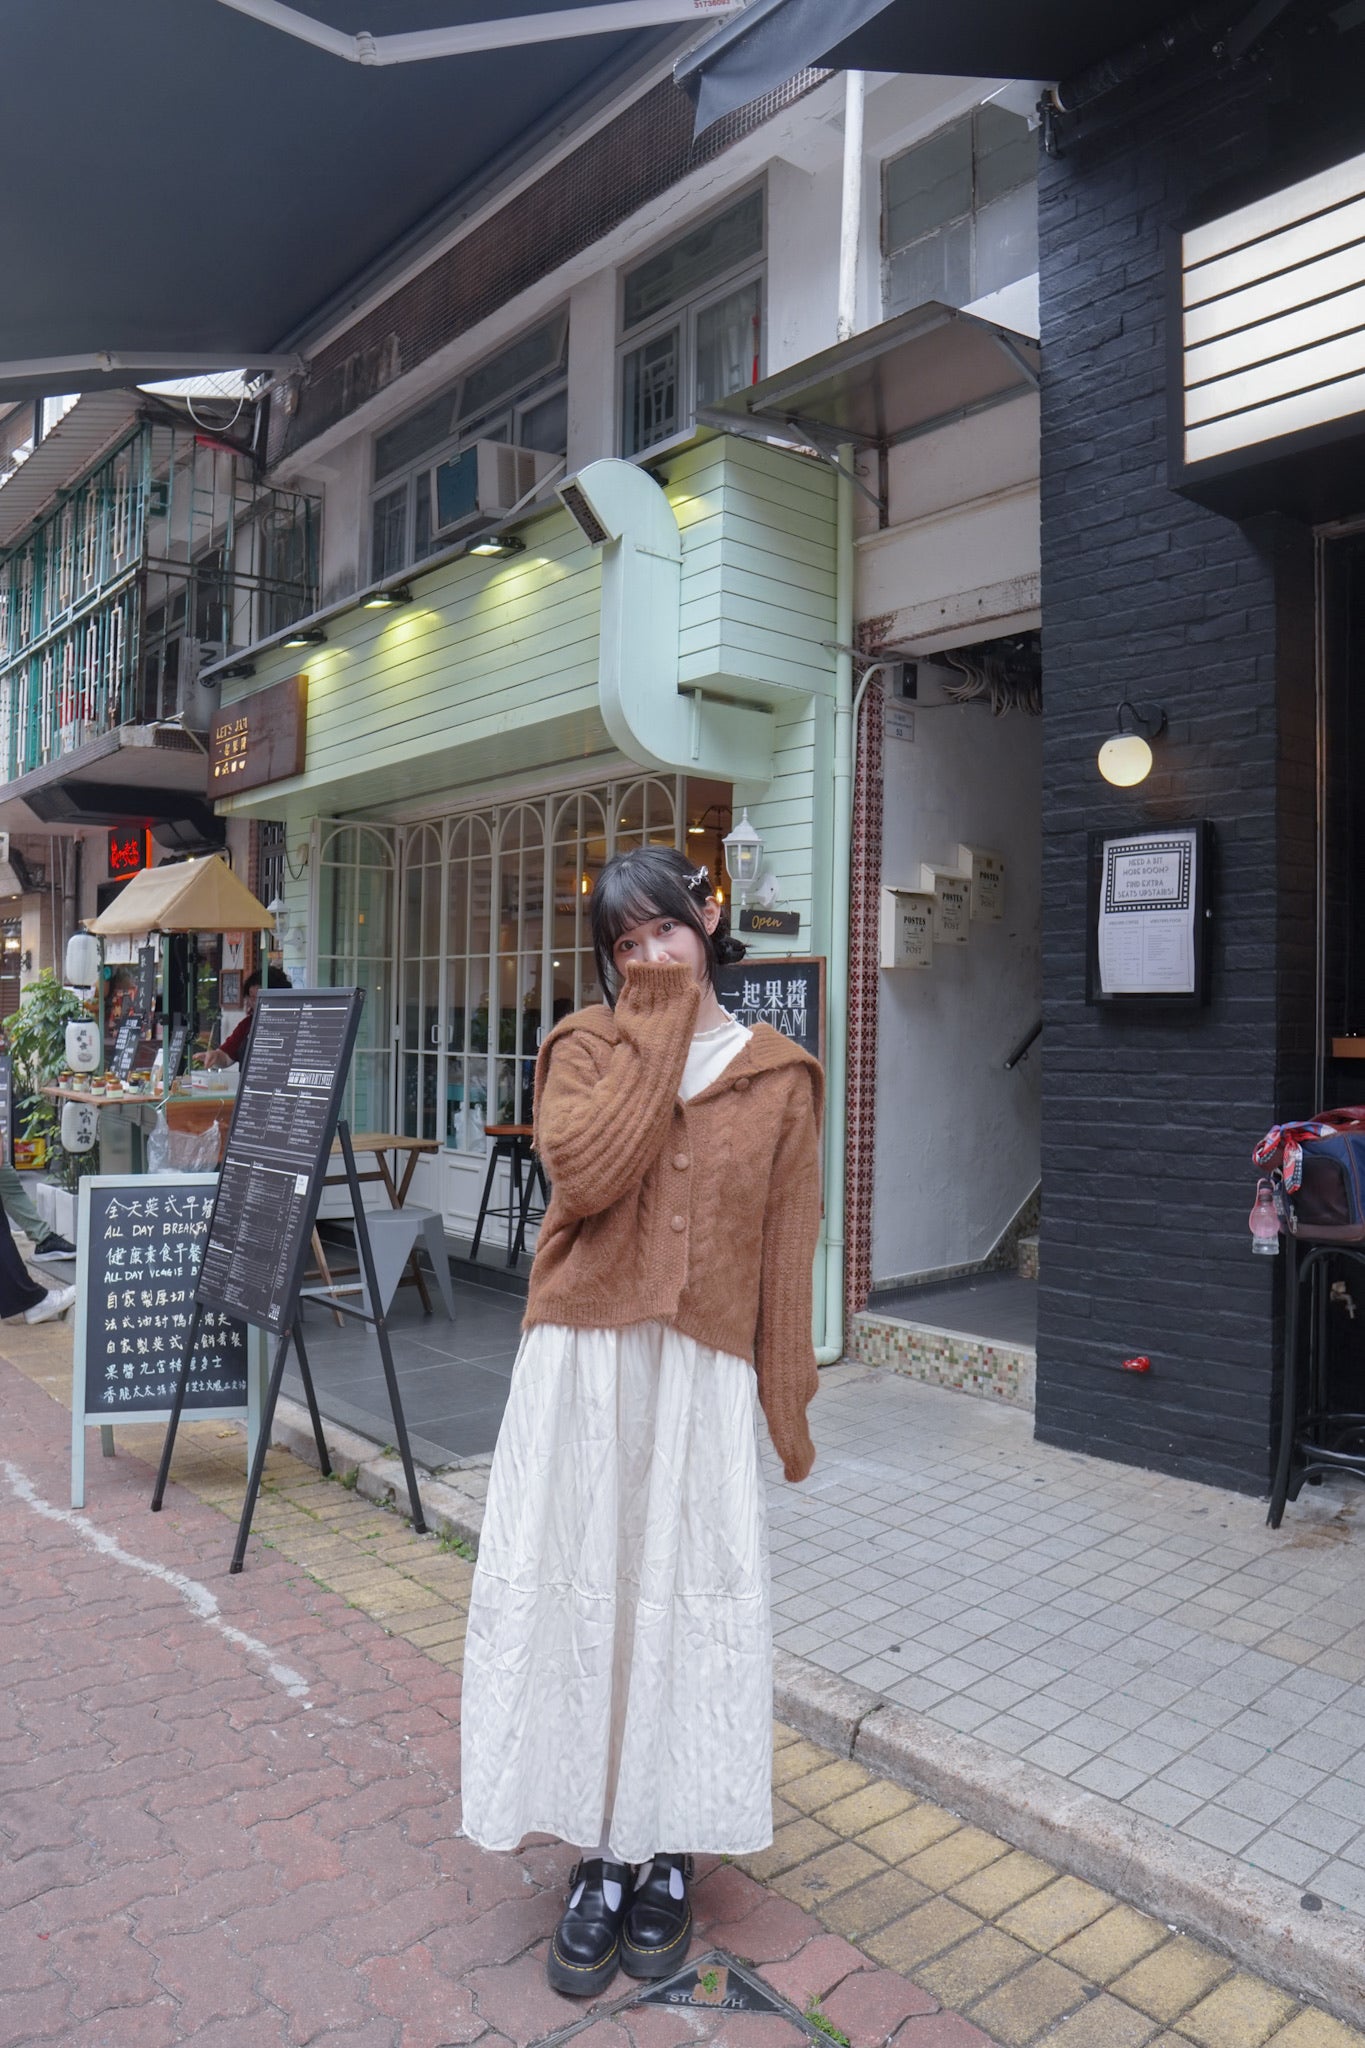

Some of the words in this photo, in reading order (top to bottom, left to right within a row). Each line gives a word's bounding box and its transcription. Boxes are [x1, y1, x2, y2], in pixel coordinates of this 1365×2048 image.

[1145, 857, 1151, 865] A
[1152, 856, 1163, 864] BIT
[979, 871, 999, 882] POSTES
[1122, 868, 1141, 876] MORE
[1142, 866, 1169, 875] ROOM?
[1126, 880, 1141, 888] FIND
[1141, 879, 1164, 887] EXTRA
[942, 892, 963, 903] POSTES
[1118, 890, 1138, 898] SEATS
[752, 915, 783, 930] Open
[903, 915, 926, 926] POSTES
[905, 946, 922, 955] POST
[721, 979, 808, 1008] 一起果醬
[105, 1194, 215, 1220] 全天英式早餐
[104, 1225, 124, 1240] ALL
[132, 1224, 155, 1238] DAY
[105, 1242, 202, 1267] 健康素食早餐
[104, 1271, 123, 1285] ALL
[124, 1270, 143, 1282] DAY
